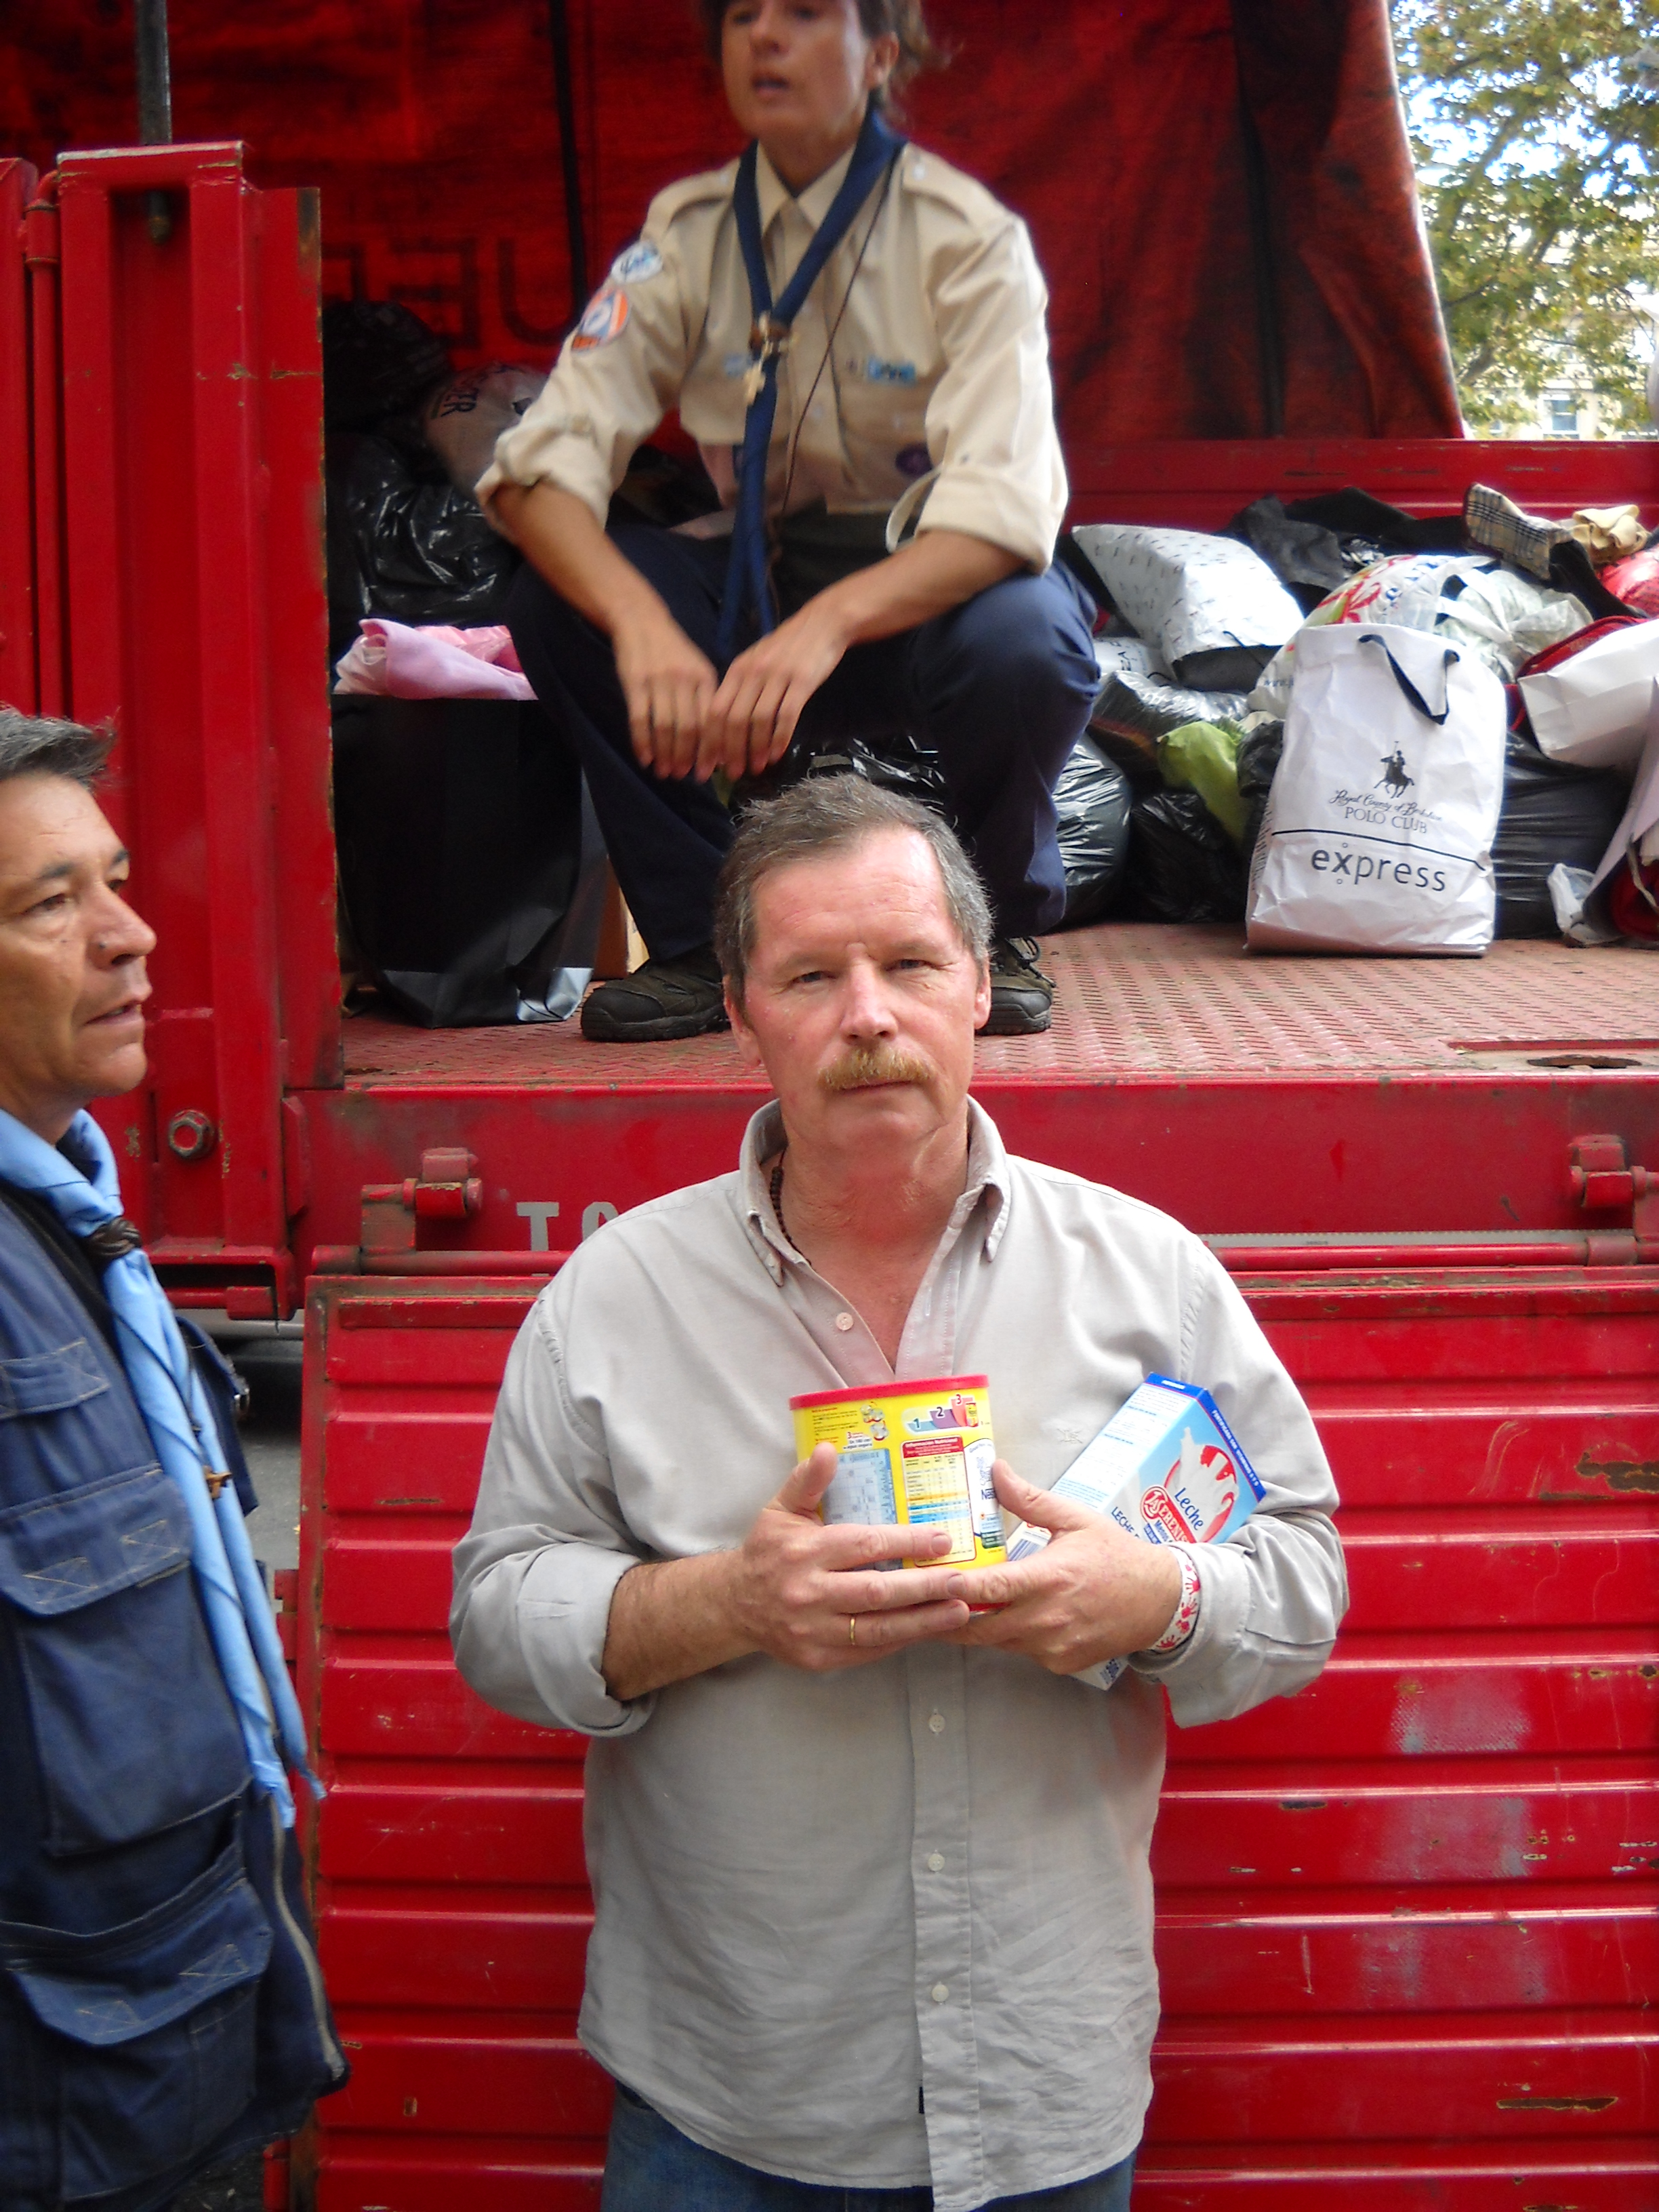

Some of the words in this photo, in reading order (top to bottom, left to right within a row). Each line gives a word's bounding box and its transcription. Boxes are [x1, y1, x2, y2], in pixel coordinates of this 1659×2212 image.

[1329, 789, 1361, 806] Royal
[1363, 794, 1392, 812] County
[1345, 806, 1387, 825] POLO
[1391, 816, 1428, 834] CLUB
[1311, 847, 1447, 893] express
[956, 1394, 962, 1405] 3
[937, 1406, 944, 1417] 2
[914, 1418, 920, 1429] 1
[1174, 1487, 1204, 1531] Leche
